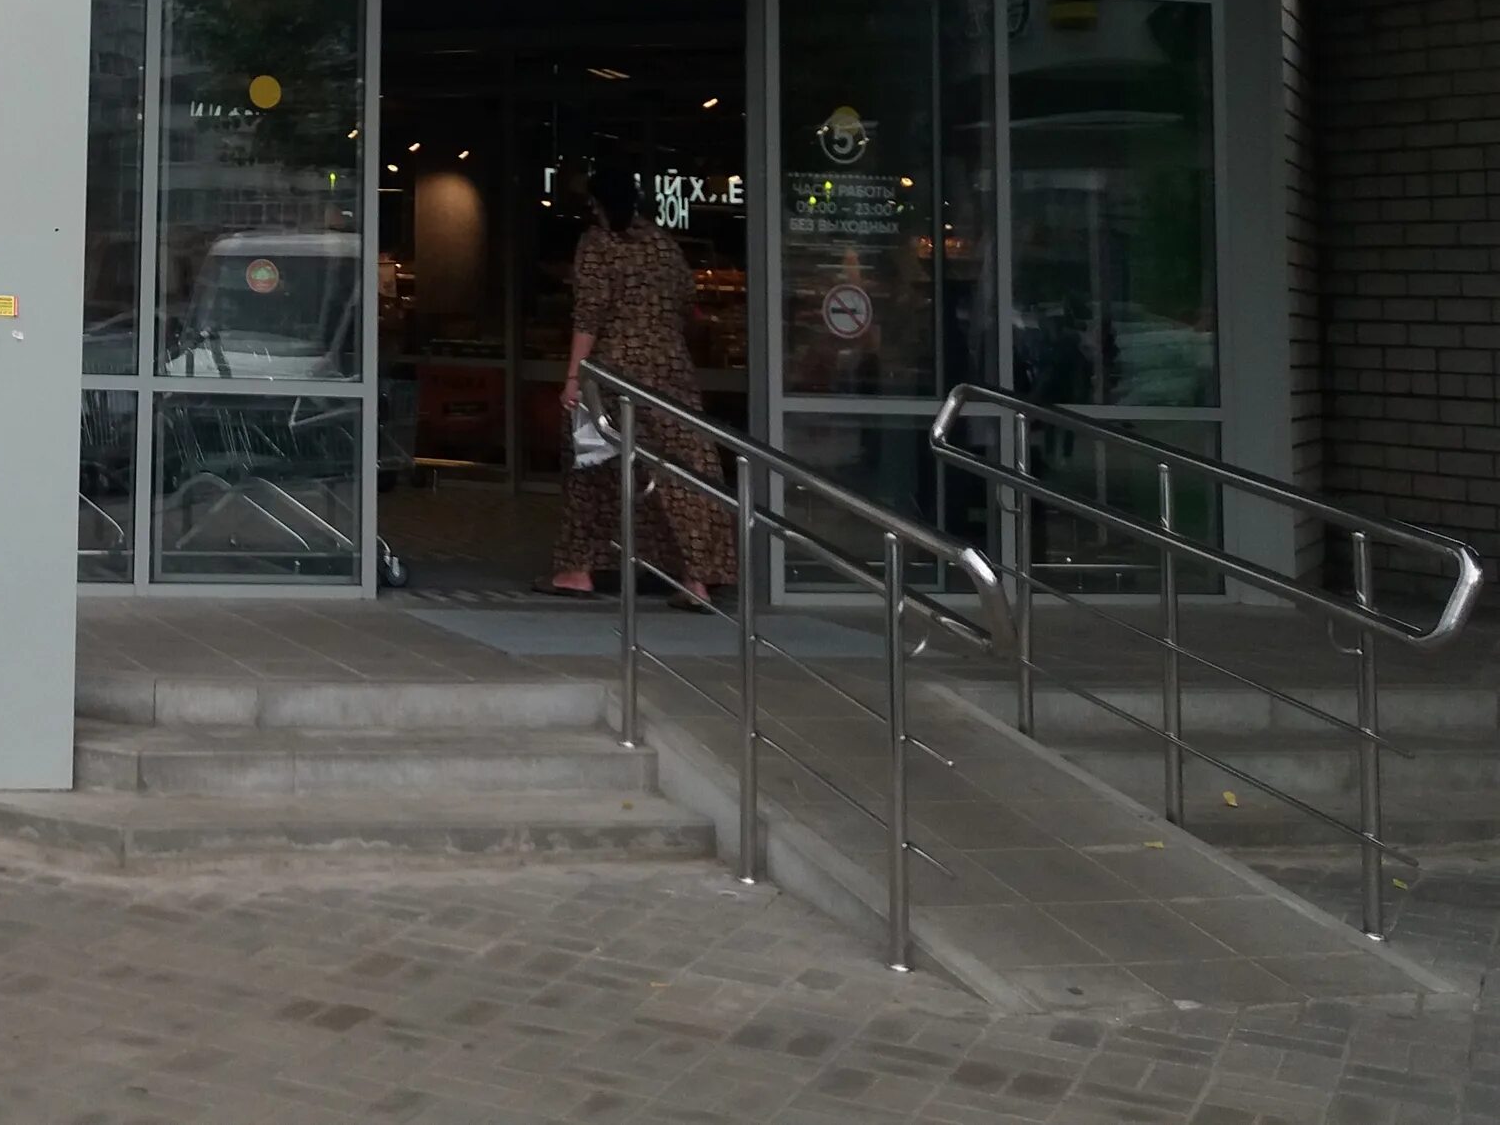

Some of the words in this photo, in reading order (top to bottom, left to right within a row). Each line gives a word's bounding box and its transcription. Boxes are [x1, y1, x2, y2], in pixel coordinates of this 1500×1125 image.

[838, 185, 896, 198] РАБОТЫ
[854, 202, 893, 216] 23:00
[789, 217, 815, 232] БЕЗ
[818, 218, 900, 234] ВЫХОДНЫХ
